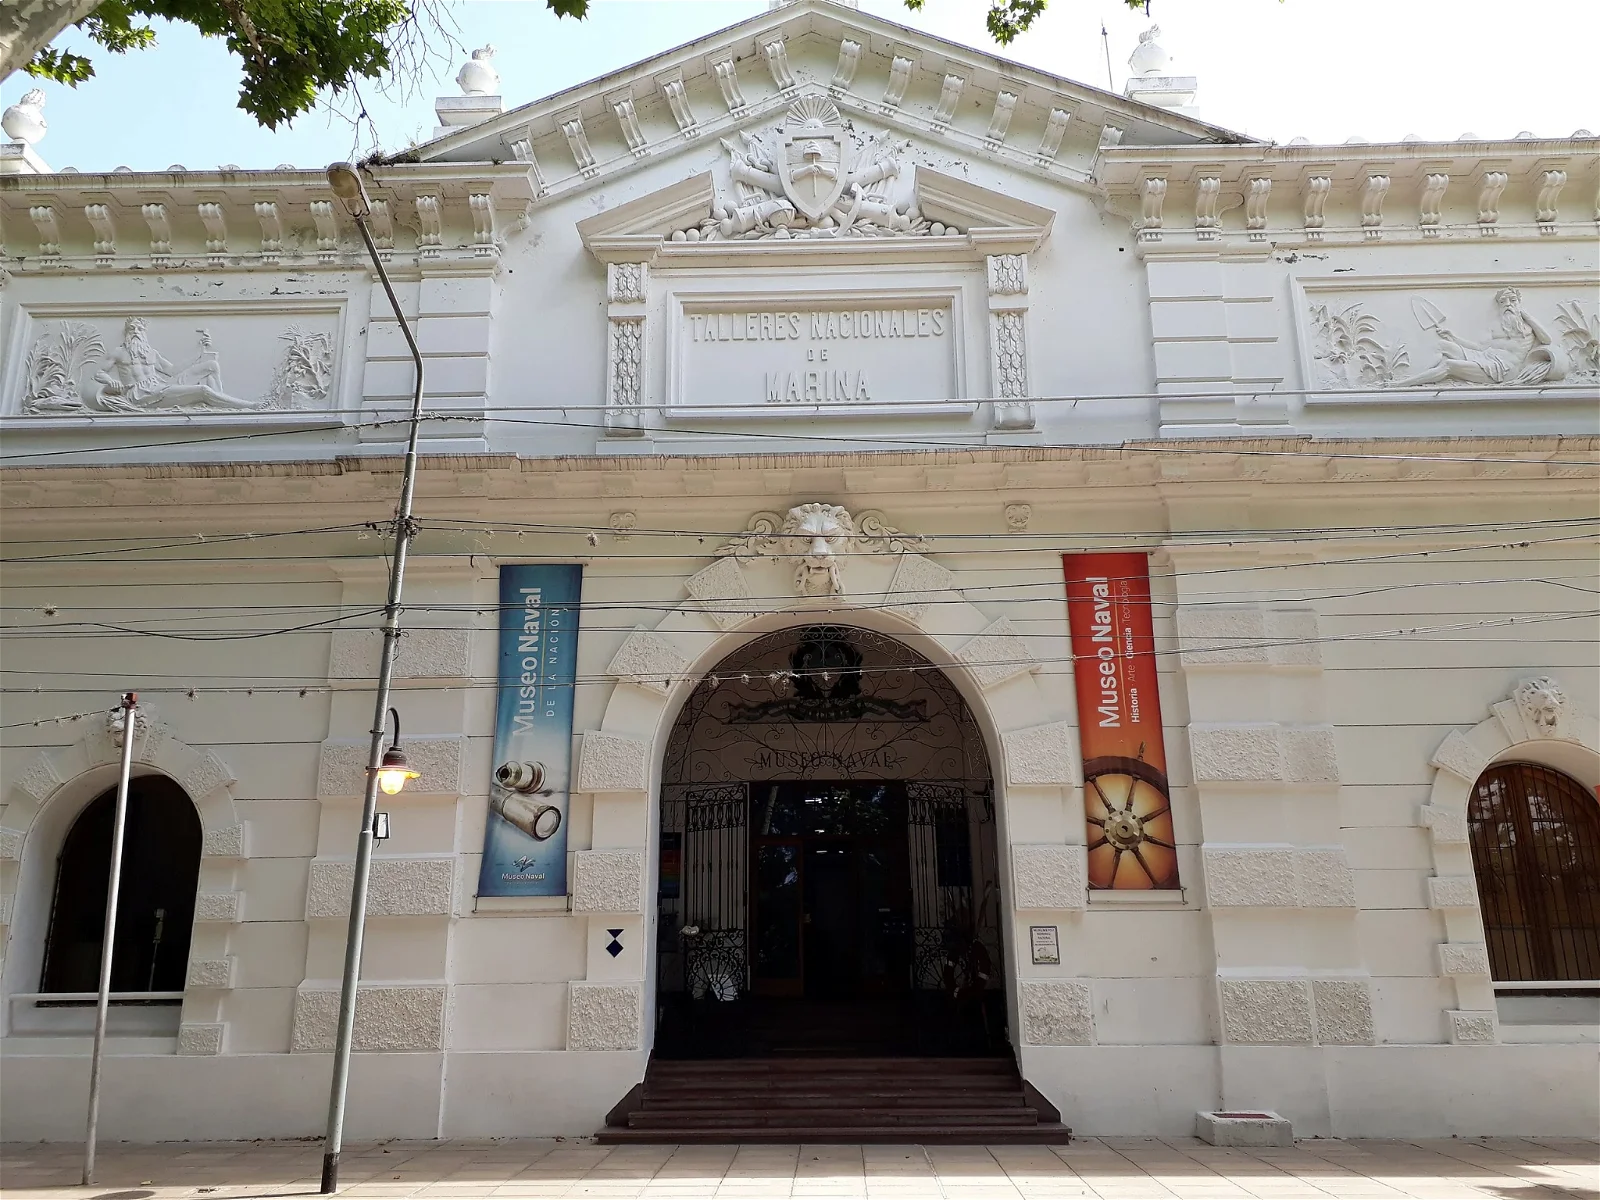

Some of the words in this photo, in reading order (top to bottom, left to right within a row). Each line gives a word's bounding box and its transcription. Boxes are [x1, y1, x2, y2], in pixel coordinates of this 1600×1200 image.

[691, 312, 800, 341] TALLERES
[811, 308, 945, 340] NACIONALES
[807, 349, 828, 361] DE
[765, 369, 871, 402] MARINA
[518, 587, 541, 652] Naval
[1086, 577, 1113, 642] Naval
[549, 608, 560, 664] NACIÓN
[1124, 627, 1135, 659] Ciencia
[548, 673, 557, 690] LA
[1097, 646, 1121, 728] Museo
[1127, 665, 1136, 682] Arte
[512, 657, 538, 736] Museo
[546, 700, 556, 717] DE
[1130, 688, 1141, 723] Historia
[759, 752, 821, 769] MUSEO
[833, 751, 894, 769] NAVAL
[525, 872, 545, 880] Naval
